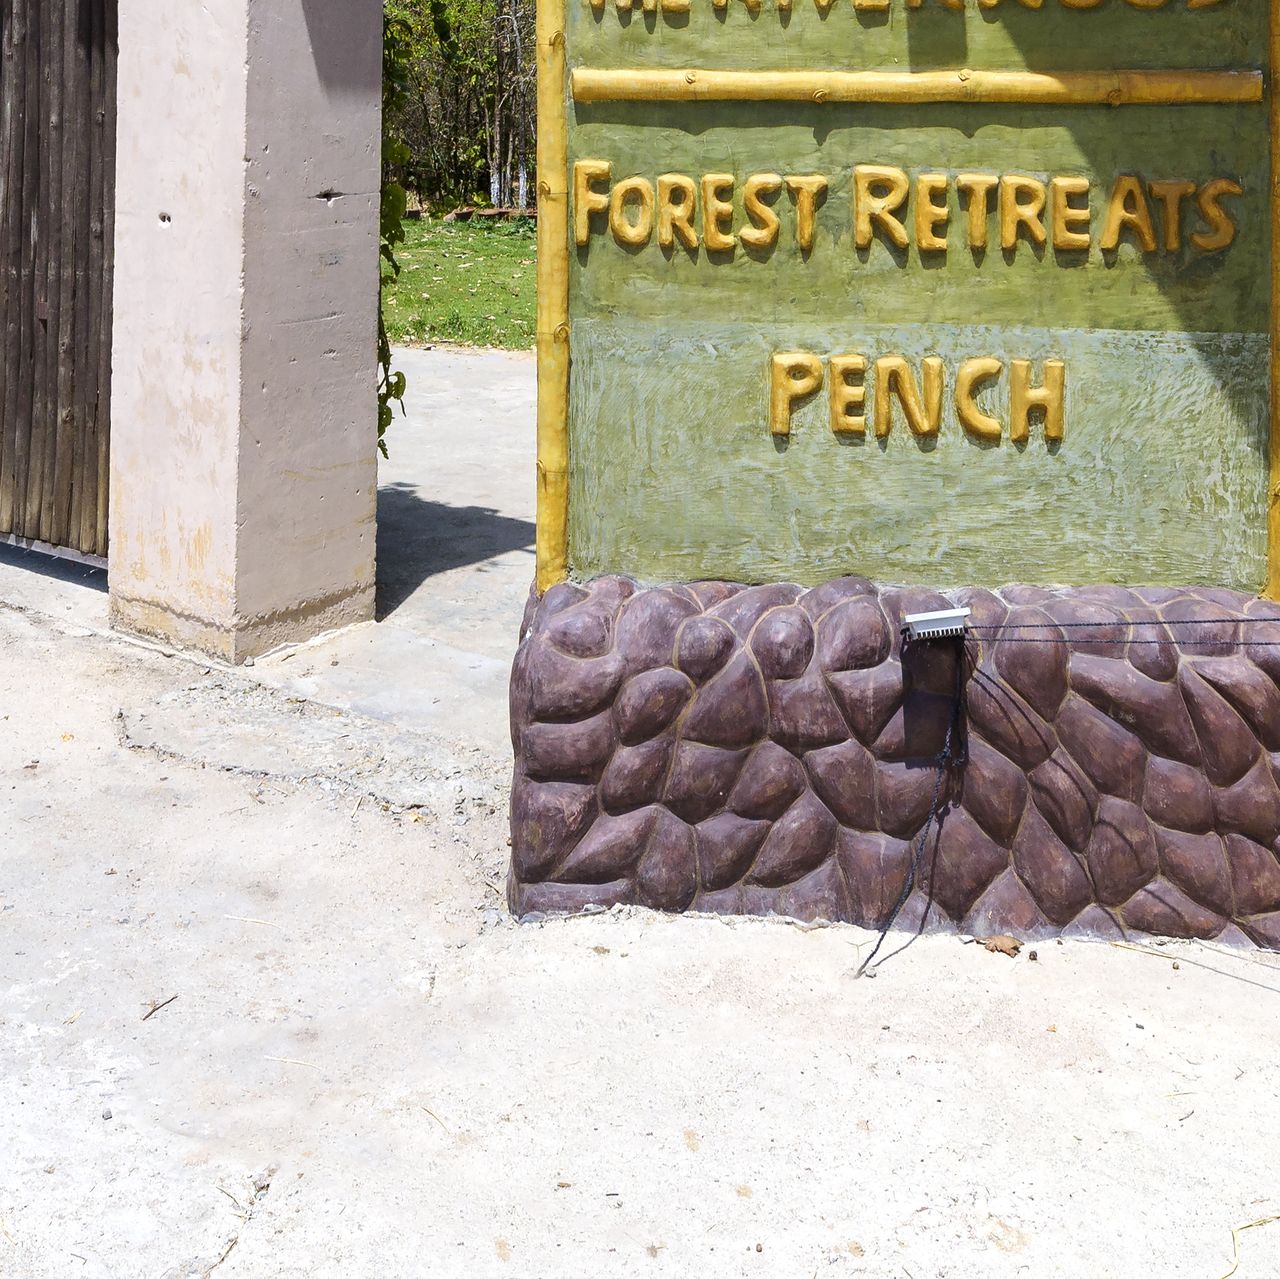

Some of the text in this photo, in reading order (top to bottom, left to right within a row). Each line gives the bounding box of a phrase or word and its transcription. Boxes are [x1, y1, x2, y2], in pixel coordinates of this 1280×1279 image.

[572, 160, 1244, 253] FOREST RETREATS
[771, 351, 1065, 441] PENCH
